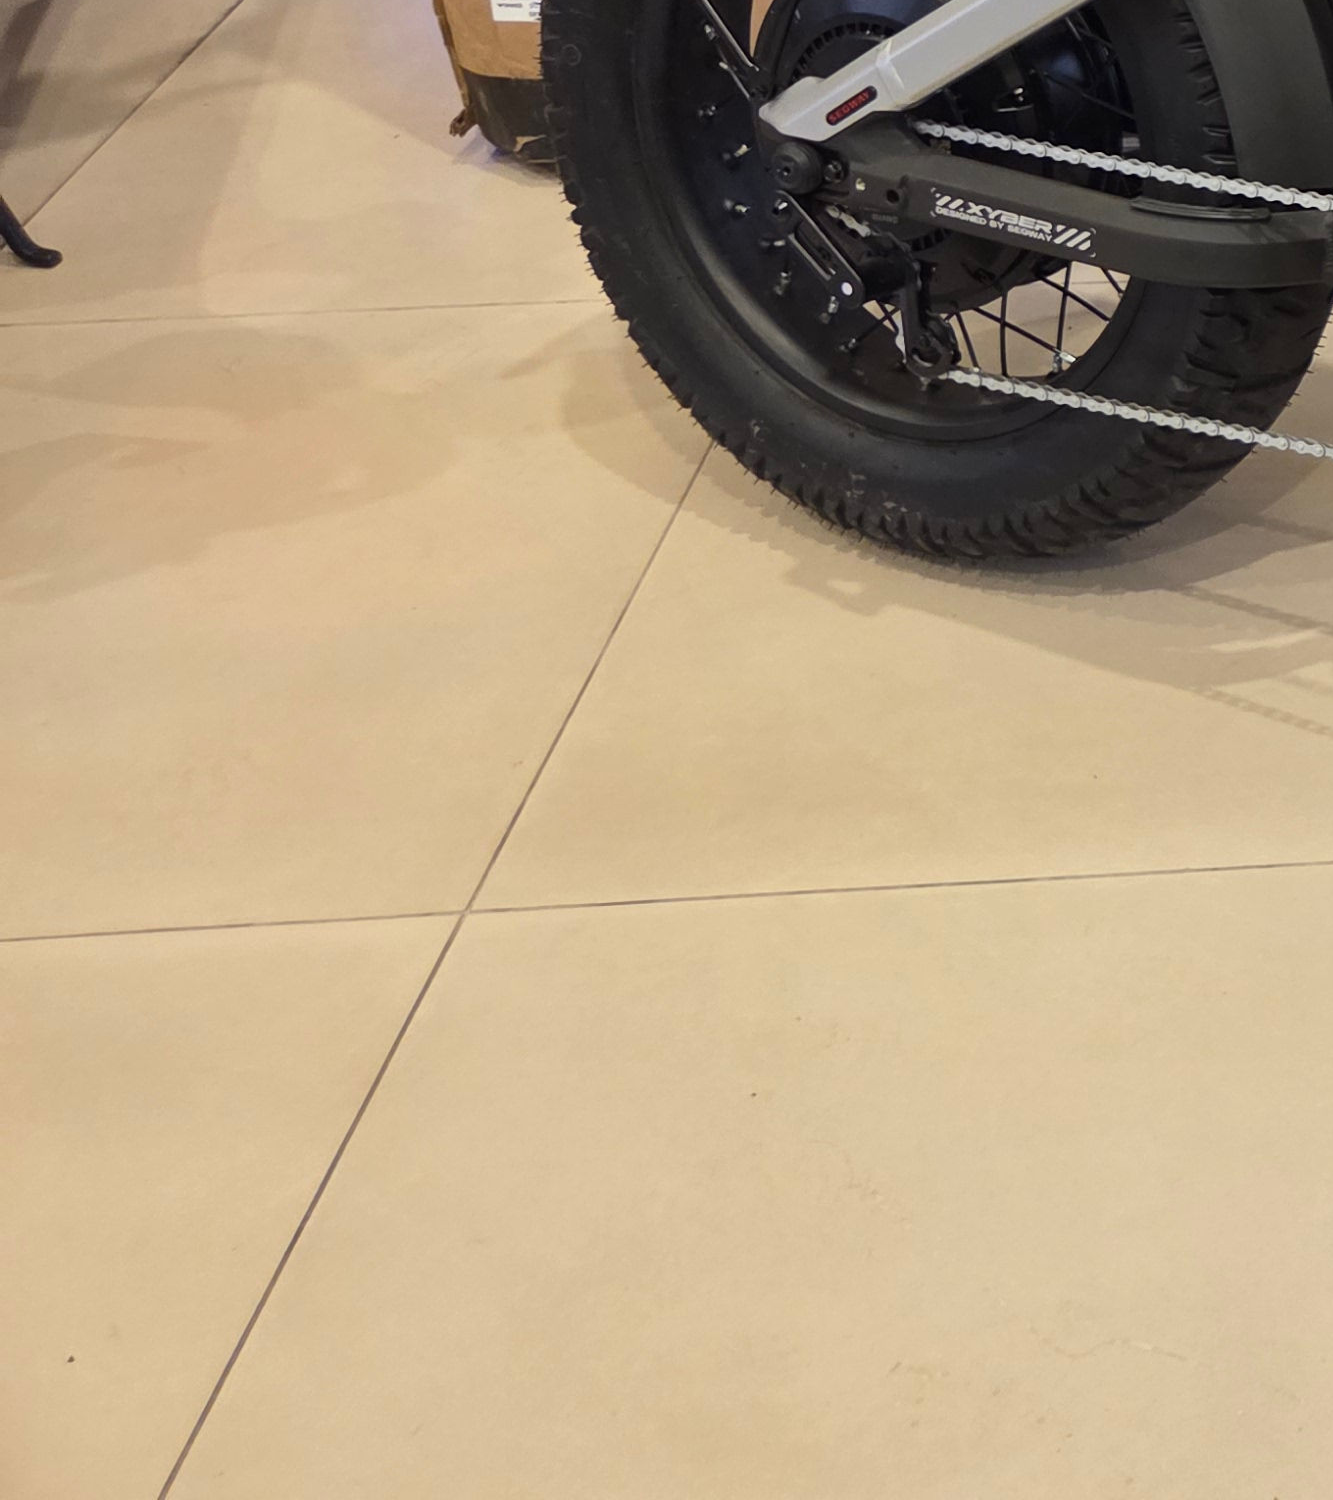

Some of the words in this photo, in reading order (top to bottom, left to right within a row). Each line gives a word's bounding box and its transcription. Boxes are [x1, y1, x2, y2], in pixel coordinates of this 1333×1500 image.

[828, 89, 871, 124] SEGWAY
[935, 205, 987, 226] DESIGNED
[989, 219, 1005, 231] BY
[1007, 225, 1053, 242] SEGWAY
[967, 202, 1053, 234] XYBER
